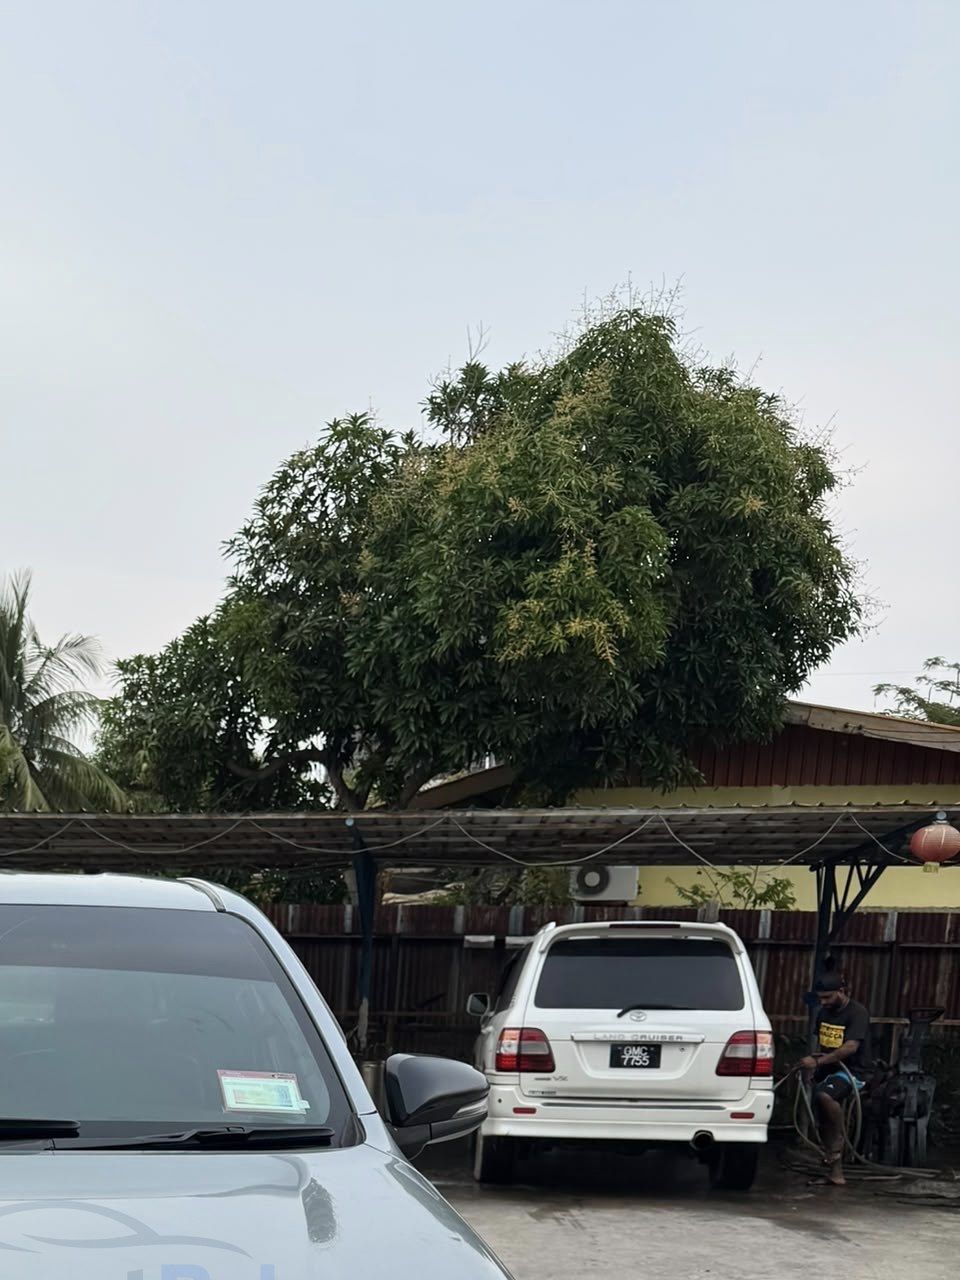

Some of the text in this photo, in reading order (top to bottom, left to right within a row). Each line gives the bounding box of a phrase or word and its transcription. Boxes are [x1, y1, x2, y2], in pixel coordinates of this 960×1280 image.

[593, 1033, 684, 1042] LAND CRUISER
[621, 1055, 650, 1066] 7755
